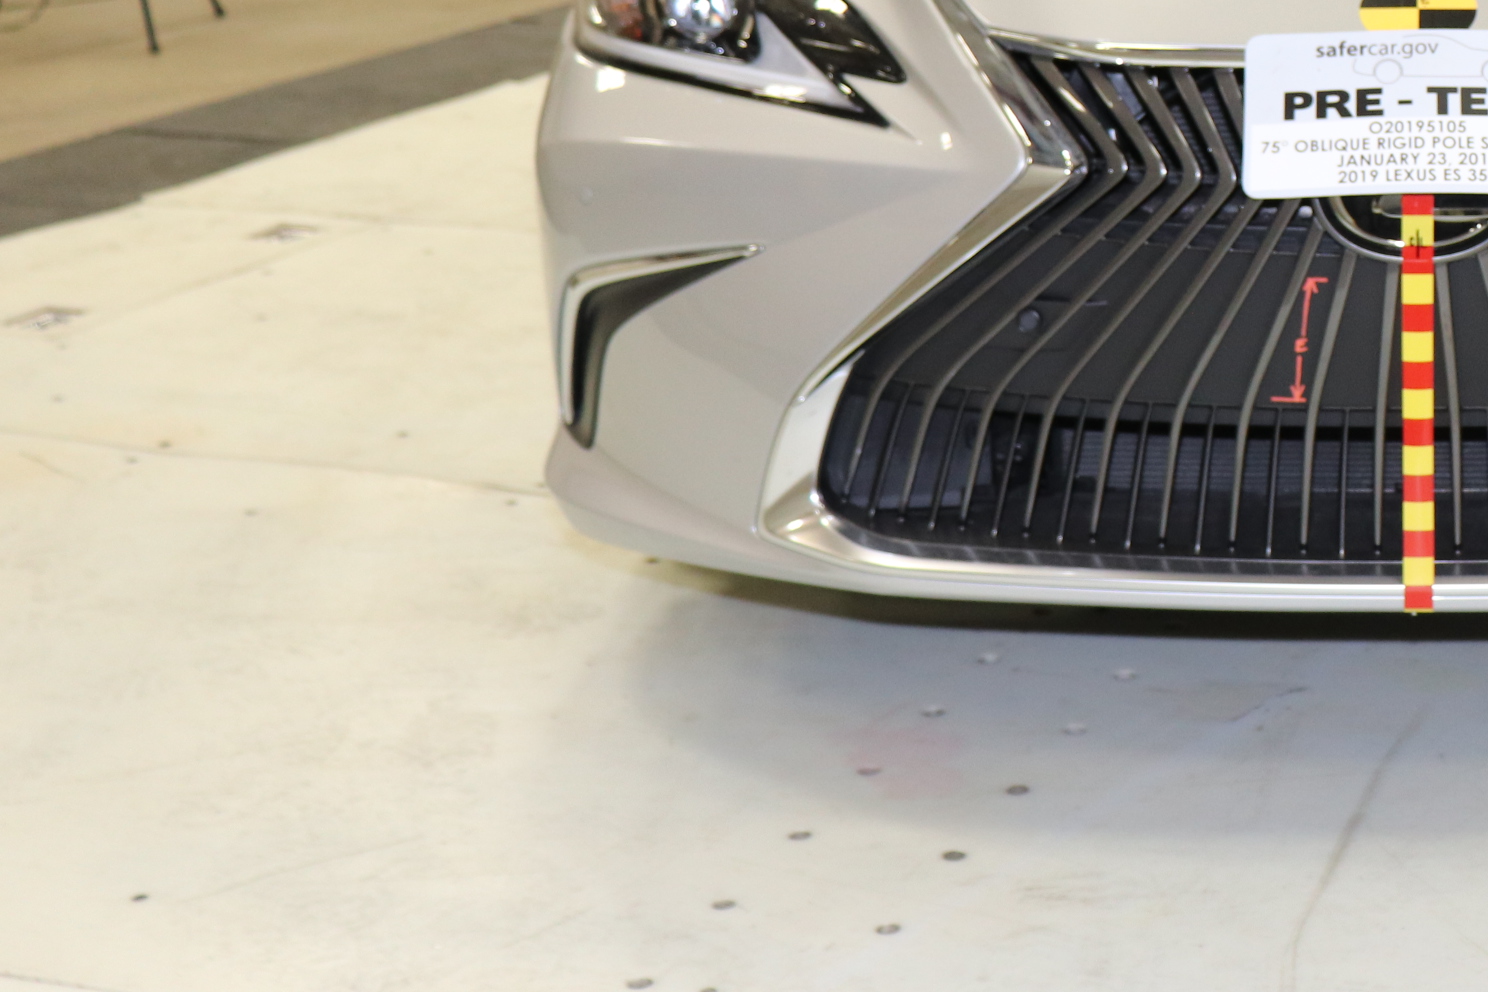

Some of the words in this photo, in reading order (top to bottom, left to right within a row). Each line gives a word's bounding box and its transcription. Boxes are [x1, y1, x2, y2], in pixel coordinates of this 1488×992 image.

[1316, 40, 1439, 59] safercar.gov
[1284, 88, 1384, 120] PRE
[1369, 120, 1467, 134] O20195105
[1294, 137, 1371, 153] OBLIQUE
[1377, 136, 1425, 150] RIGID
[1432, 135, 1475, 149] POLE
[1337, 152, 1420, 168] JANUARY
[1427, 152, 1452, 167] 23,
[1338, 169, 1379, 184] 2019
[1386, 168, 1436, 182] LEXUS
[1443, 168, 1462, 182] ES
